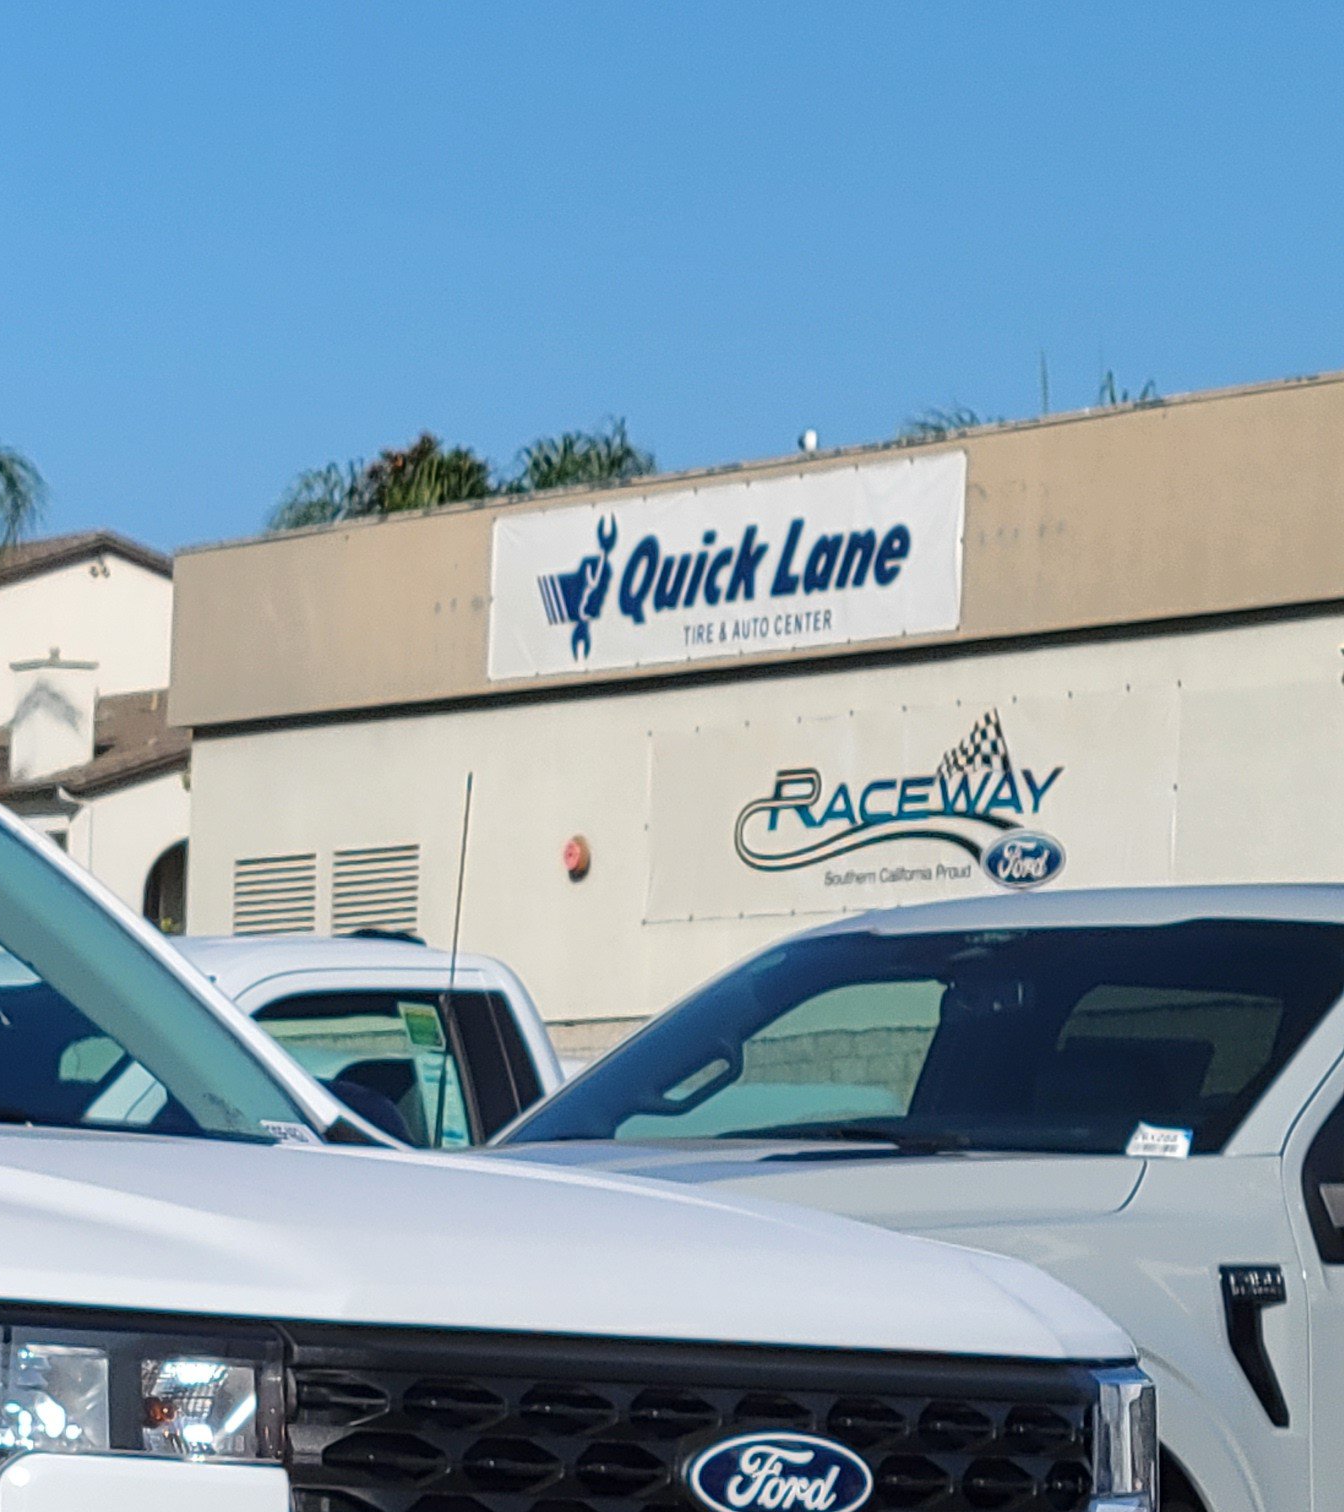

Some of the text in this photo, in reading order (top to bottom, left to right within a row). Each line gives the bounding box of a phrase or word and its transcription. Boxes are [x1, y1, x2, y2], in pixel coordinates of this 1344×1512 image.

[618, 518, 912, 625] Quick Lane
[683, 608, 833, 647] TIRE & AUTO CENTER
[766, 766, 1065, 832] RACEWAY
[823, 862, 972, 888] Southern California Proud
[997, 840, 1051, 879] Ford
[727, 1444, 841, 1511] Ford
